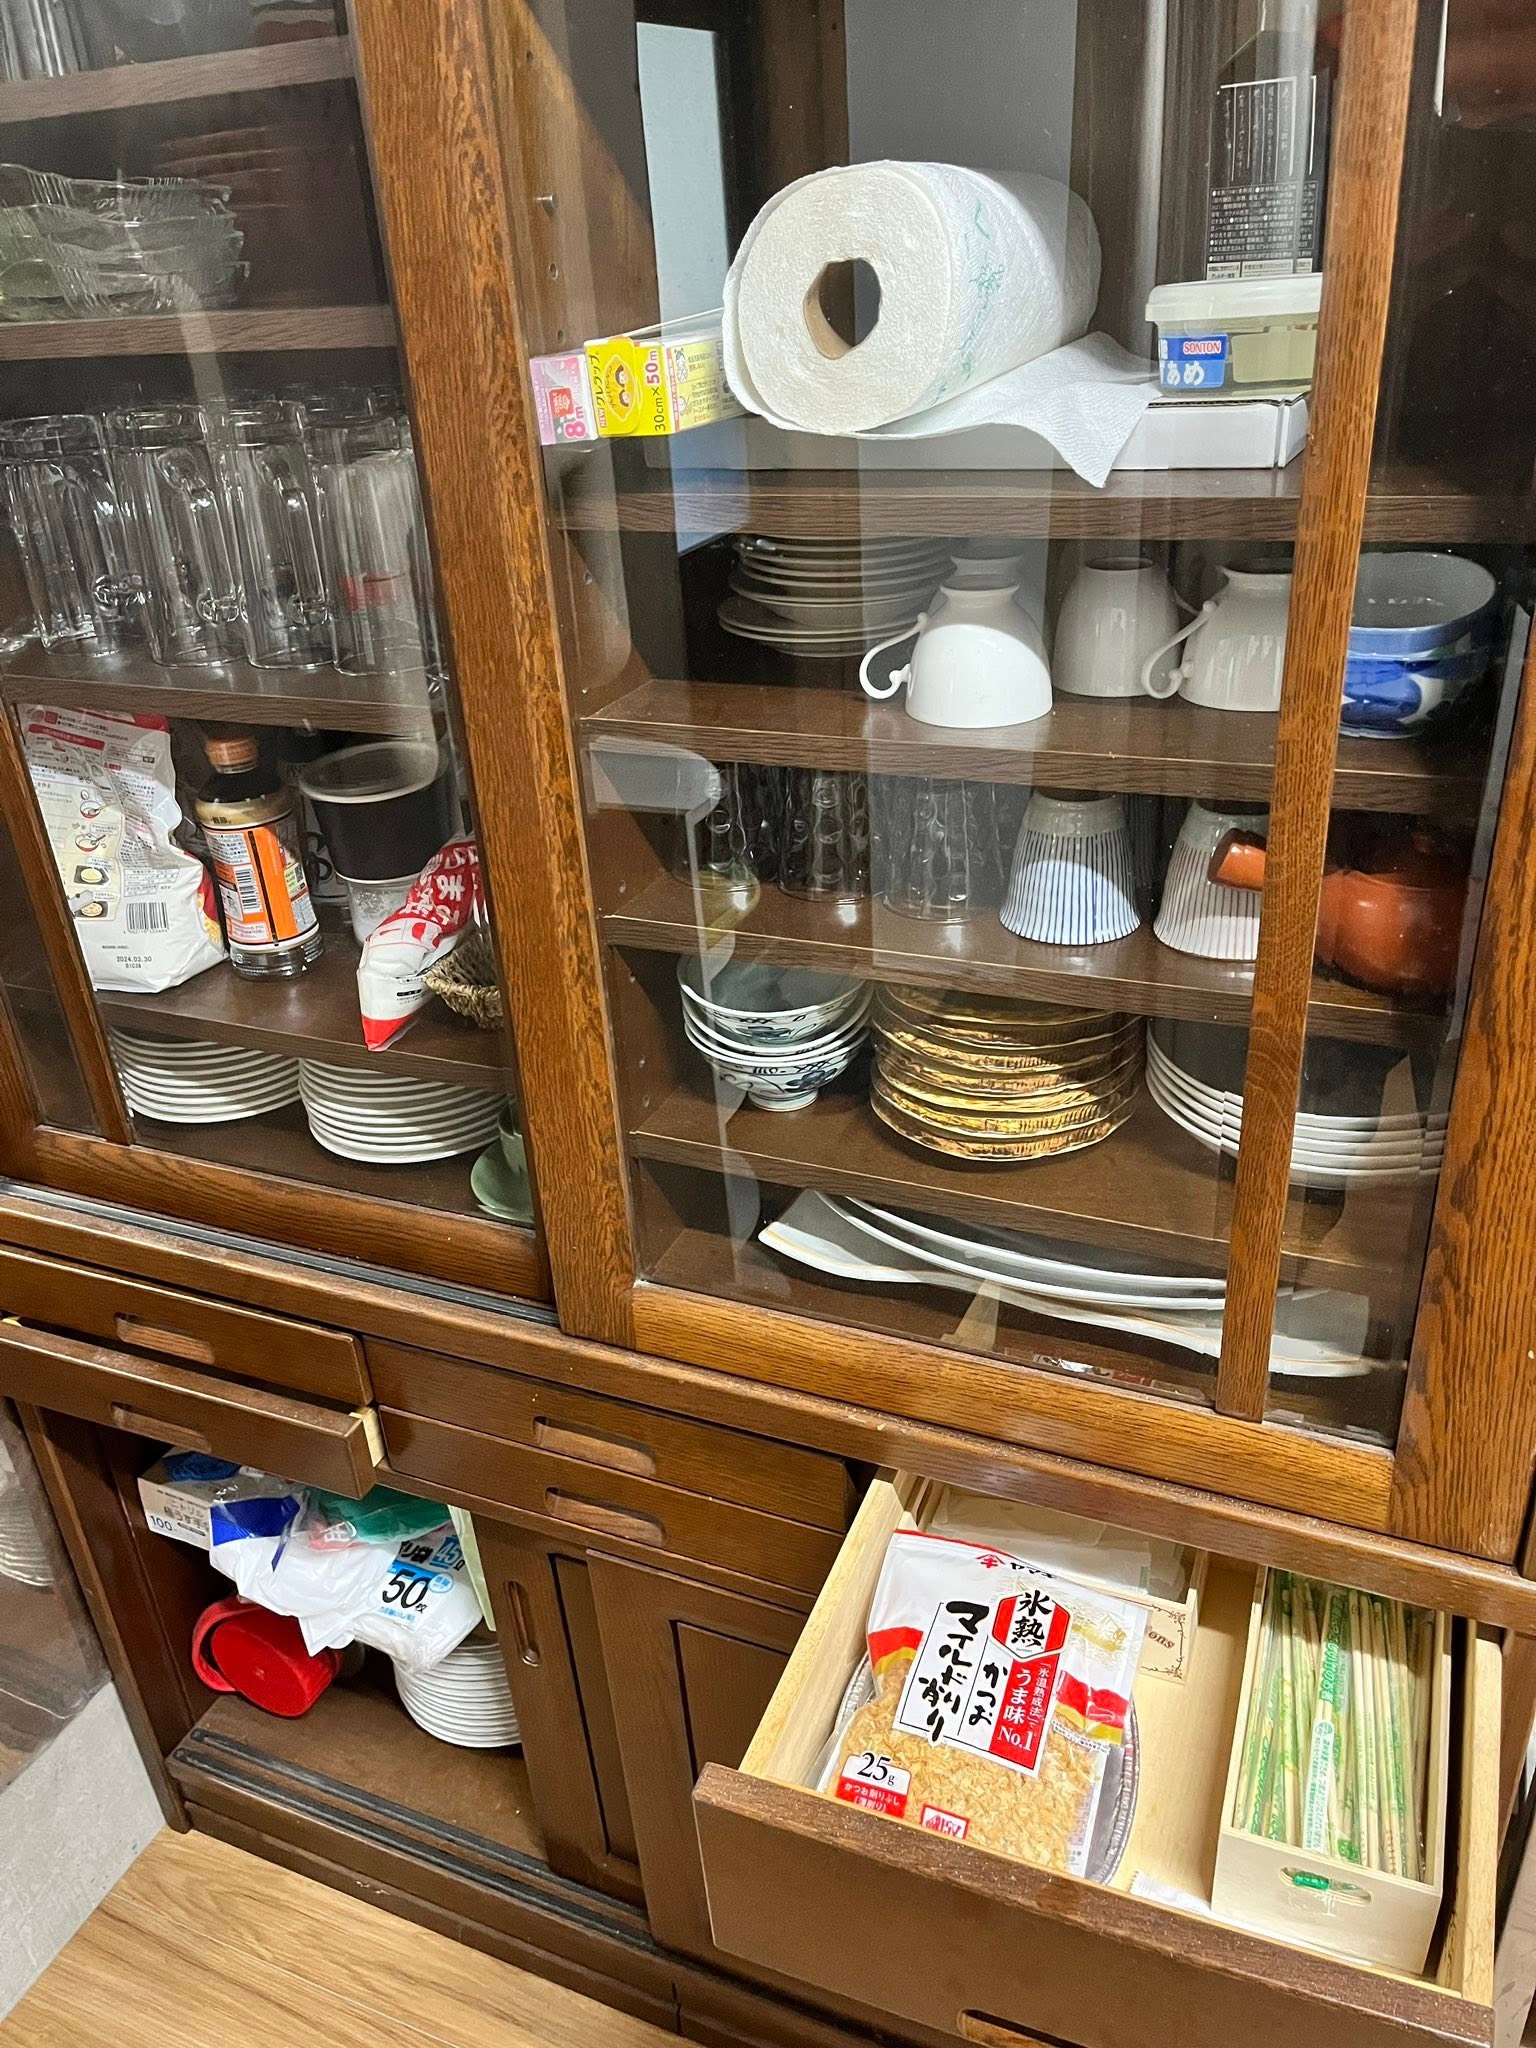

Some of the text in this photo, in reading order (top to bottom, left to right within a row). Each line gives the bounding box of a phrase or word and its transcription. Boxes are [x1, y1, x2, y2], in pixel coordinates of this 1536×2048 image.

[1183, 341, 1221, 354] SONTON
[589, 353, 606, 409] クレラップ
[565, 407, 587, 439] 8m
[116, 955, 152, 963] 2024.03.30
[1011, 1589, 1052, 1648] 氷熟
[968, 1662, 1008, 1726] かつお
[857, 1752, 895, 1786] 25g
